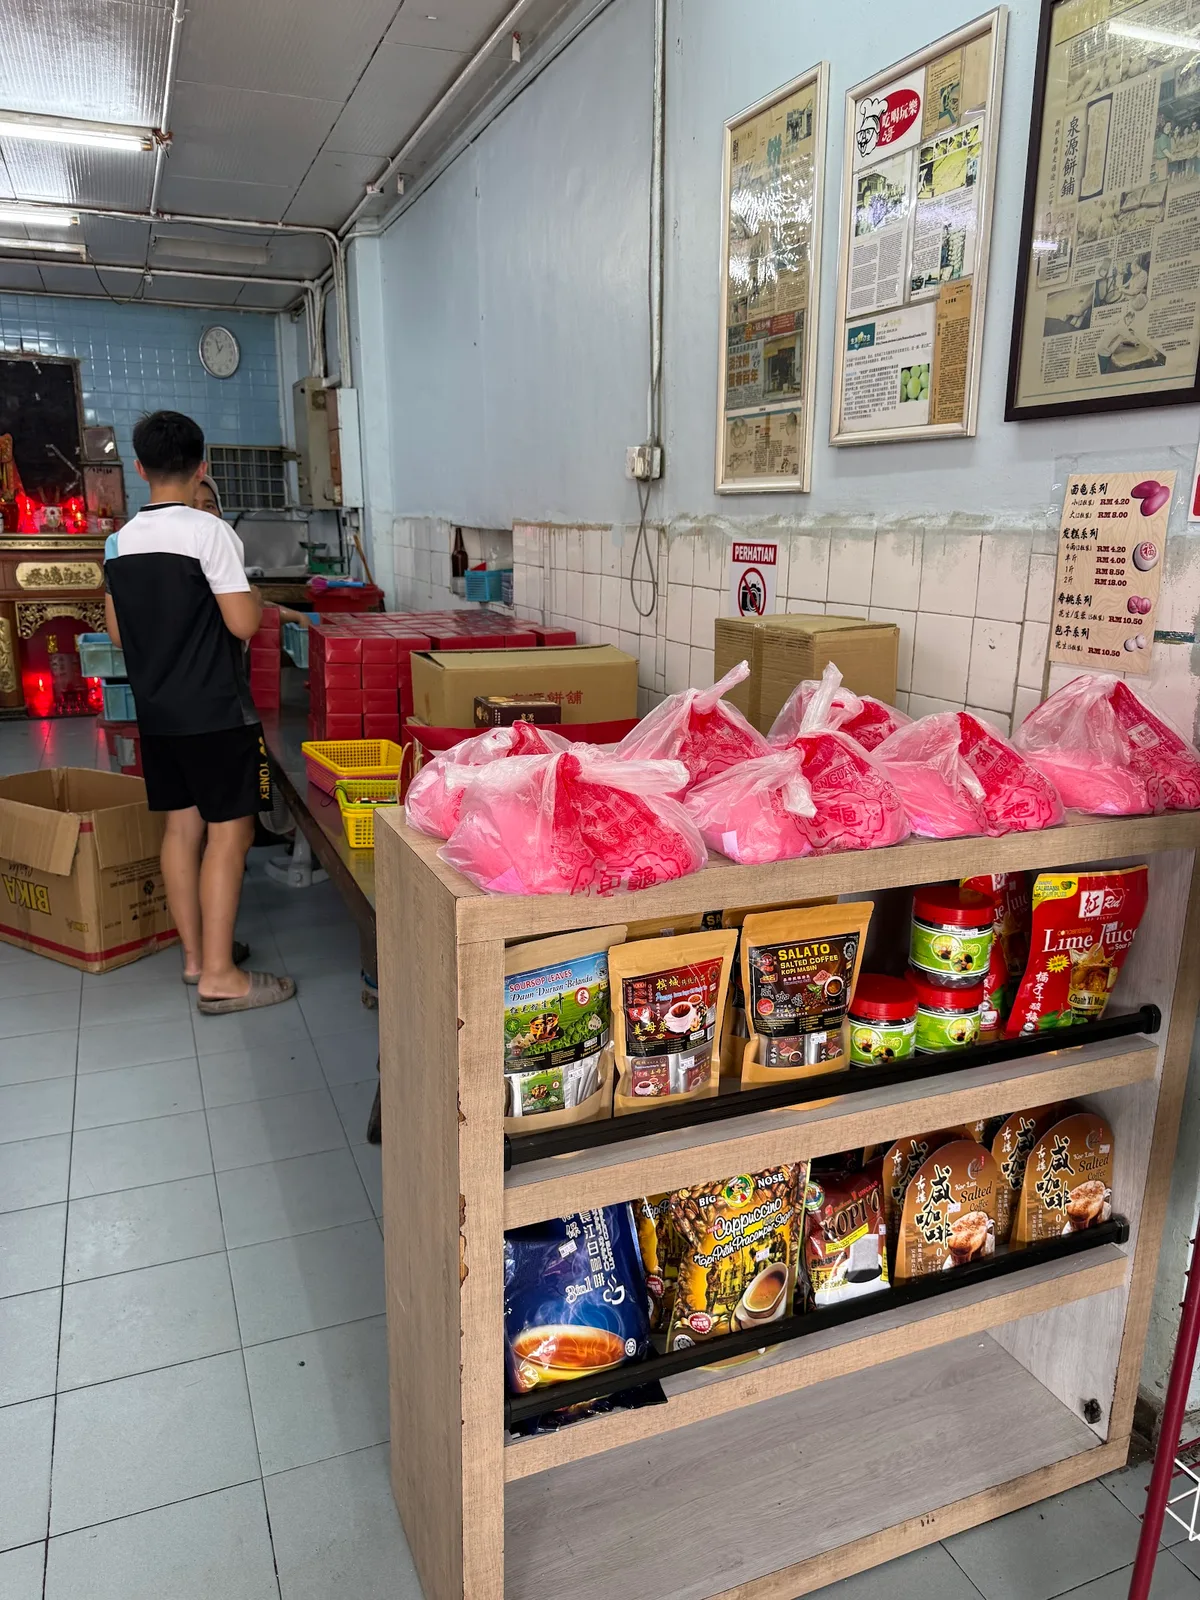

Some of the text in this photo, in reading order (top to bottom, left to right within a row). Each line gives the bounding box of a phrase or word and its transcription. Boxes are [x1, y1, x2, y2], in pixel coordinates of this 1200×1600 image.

[734, 545, 775, 563] PERHATIAN
[1123, 617, 1143, 625] 10.50
[1055, 624, 1090, 640] 包子系列
[1102, 649, 1120, 657] 10.50
[260, 762, 270, 800] YONEX
[1, 873, 52, 916] BIKA
[1102, 895, 1122, 909] Red
[1041, 928, 1093, 953] Lime
[778, 943, 831, 961] SALATO
[780, 954, 839, 969] SALTED COFFEE
[781, 964, 818, 976] KOPI MASIN
[509, 969, 573, 993] SOURSOP LEAVES
[510, 974, 593, 1002] Daun Durian Belanda
[1079, 1155, 1110, 1173] Salted
[1035, 1134, 1076, 1216] 咸咖啡
[1087, 1169, 1106, 1182] Coffee
[698, 1172, 785, 1207] BIG NOSE
[960, 1180, 993, 1204] Salted
[915, 1163, 956, 1250] 咸咖啡
[969, 1198, 989, 1212] Coffee
[713, 1197, 783, 1240] Cappuccino
[822, 1198, 868, 1241] KOPI
[693, 1253, 716, 1267] Kopi
